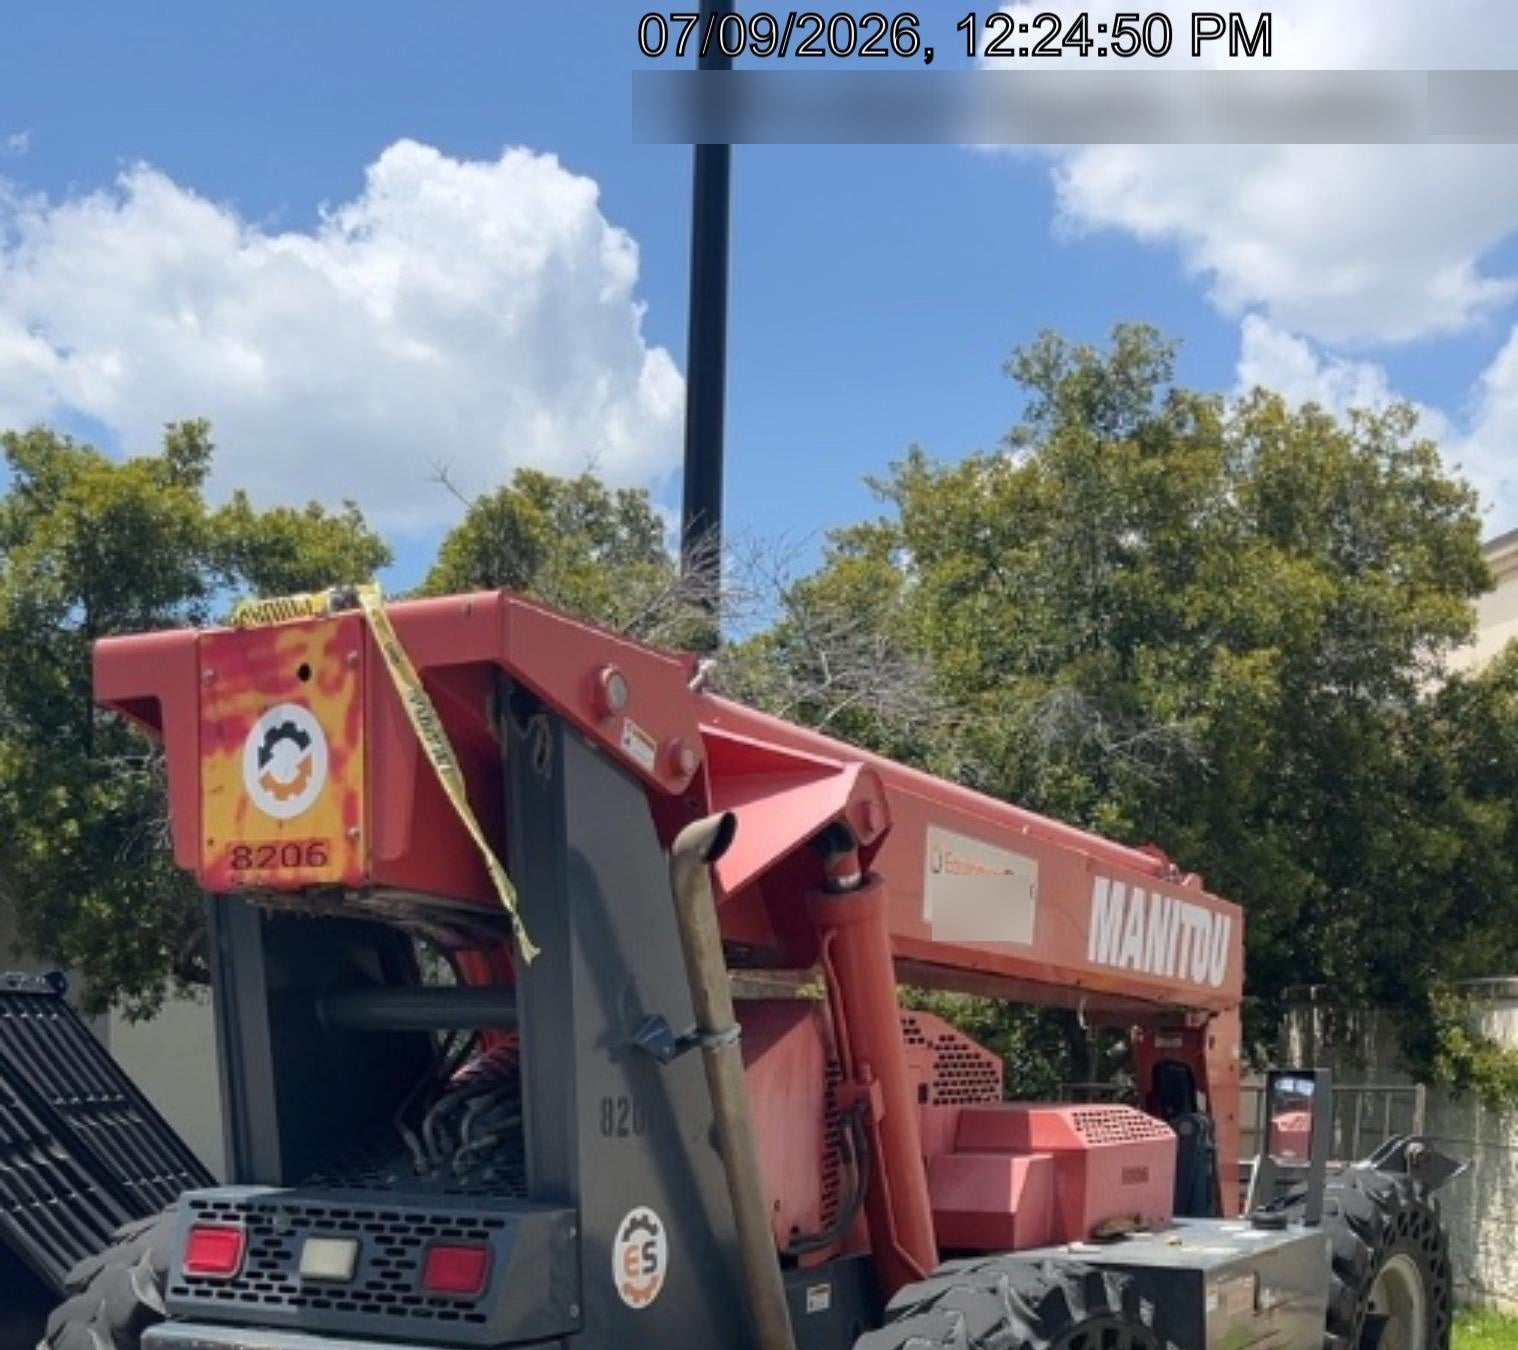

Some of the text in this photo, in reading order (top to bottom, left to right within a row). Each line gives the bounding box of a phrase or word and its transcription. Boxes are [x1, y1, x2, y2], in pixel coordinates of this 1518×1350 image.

[231, 841, 329, 870] 8206
[1088, 875, 1231, 988] MANITOU
[623, 1240, 658, 1277] ES
